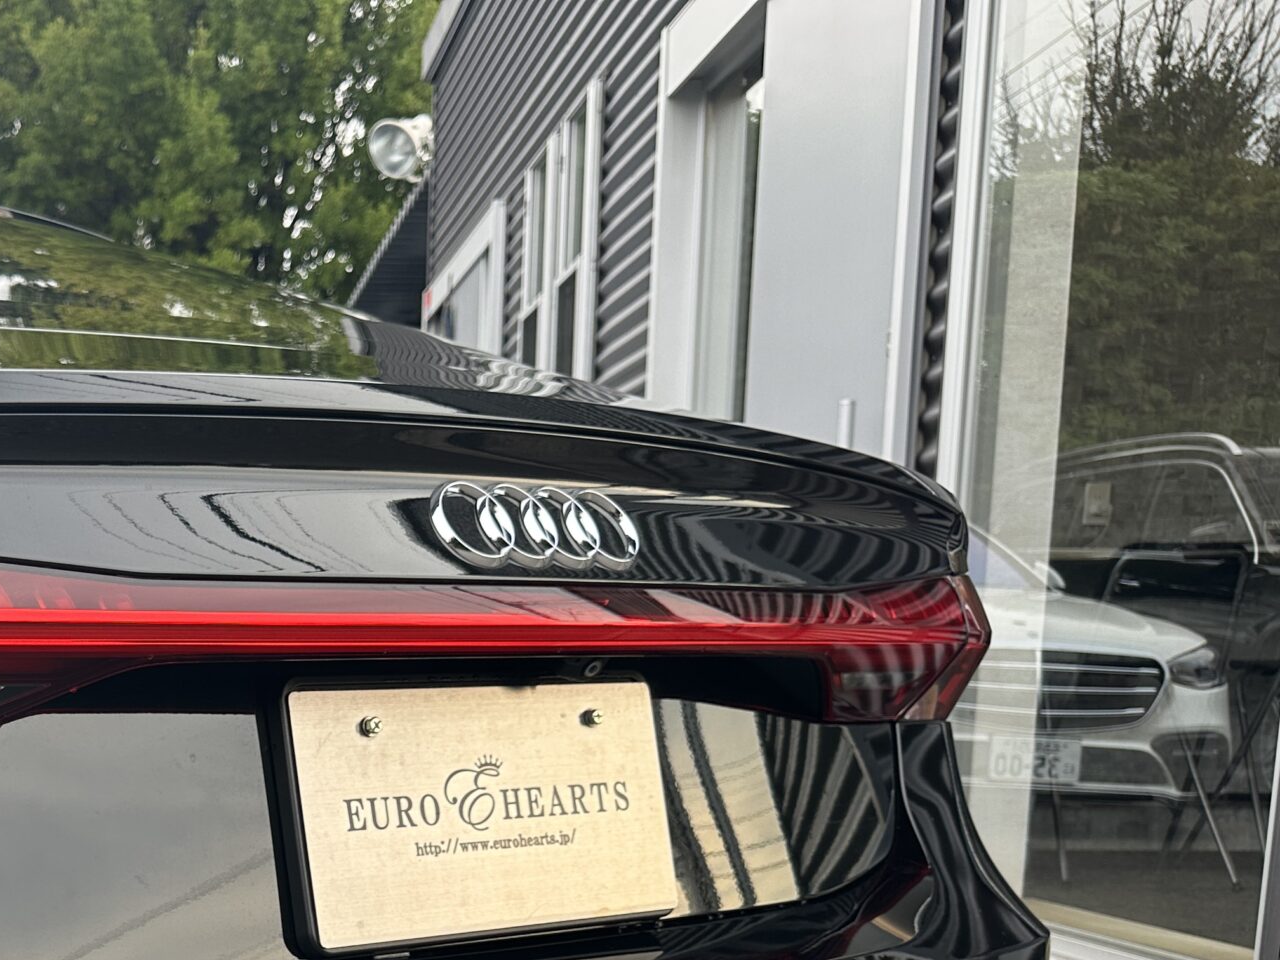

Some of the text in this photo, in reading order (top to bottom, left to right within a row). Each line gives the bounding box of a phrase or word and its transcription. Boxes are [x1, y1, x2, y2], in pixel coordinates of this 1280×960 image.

[343, 793, 441, 832] EURO
[499, 781, 631, 820] HEARTS
[415, 828, 577, 857] http://www.eurohearts.jp/
